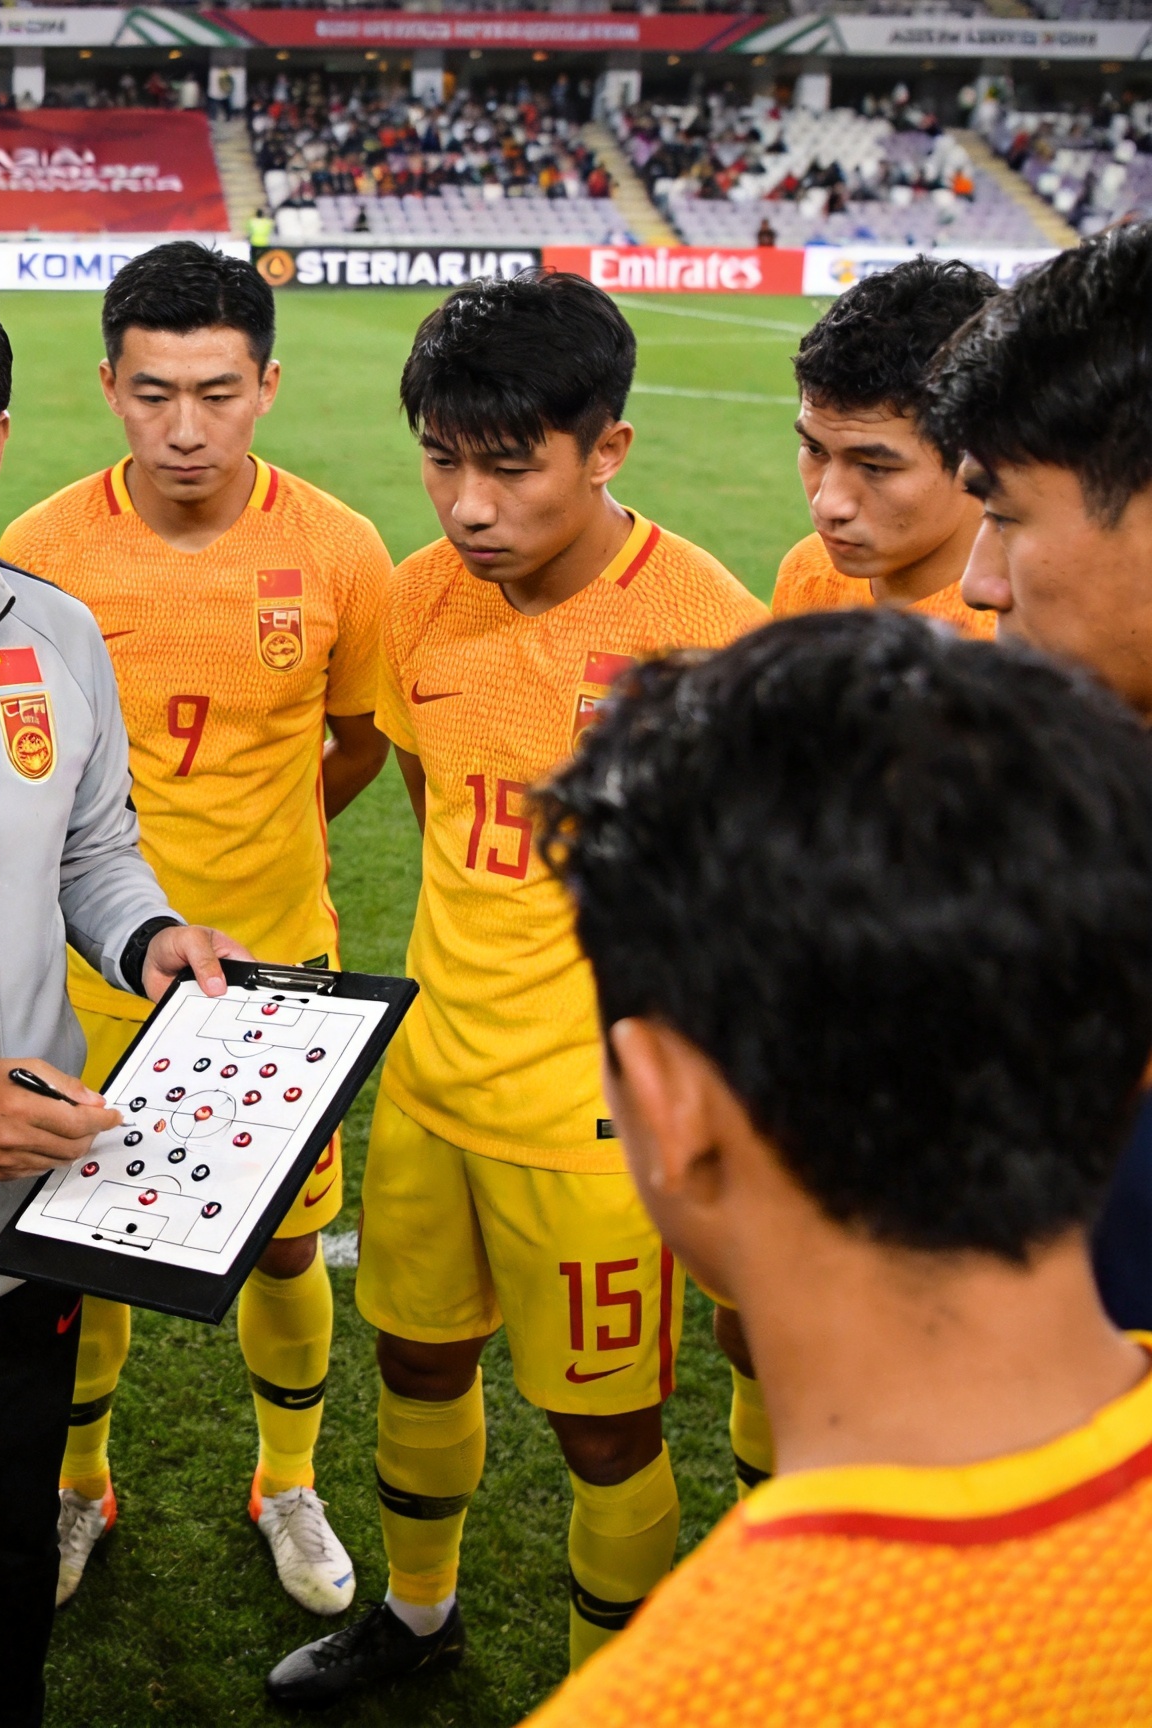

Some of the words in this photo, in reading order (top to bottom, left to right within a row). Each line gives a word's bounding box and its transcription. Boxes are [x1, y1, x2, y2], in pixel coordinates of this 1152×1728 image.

[590, 248, 762, 289] Emirates
[168, 695, 209, 776] 9
[465, 774, 532, 880] 15
[559, 1258, 642, 1351] 15
